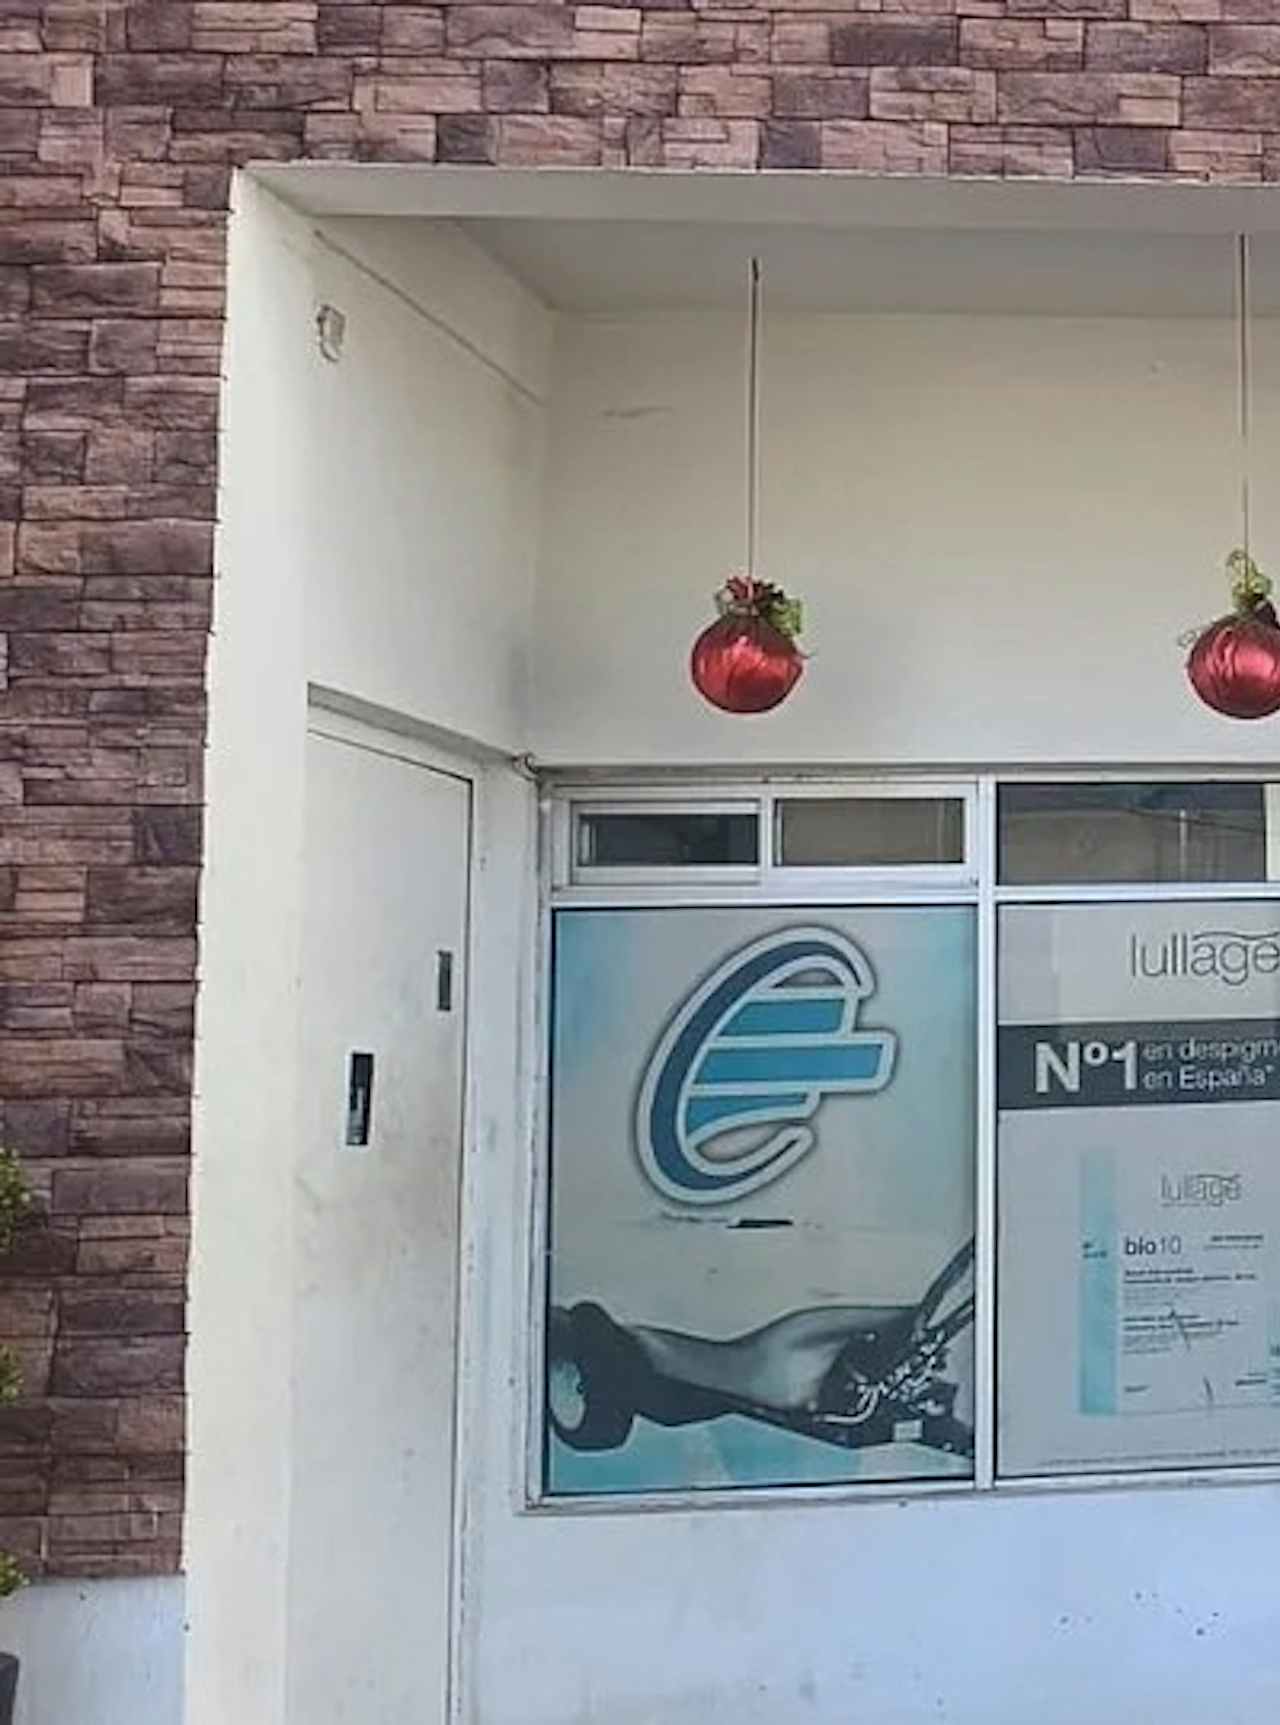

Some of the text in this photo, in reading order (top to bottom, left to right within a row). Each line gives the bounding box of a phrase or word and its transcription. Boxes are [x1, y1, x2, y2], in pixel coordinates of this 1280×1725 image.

[1129, 930, 1280, 986] lullage
[1143, 1044, 1173, 1061] en
[1143, 1070, 1173, 1089] en
